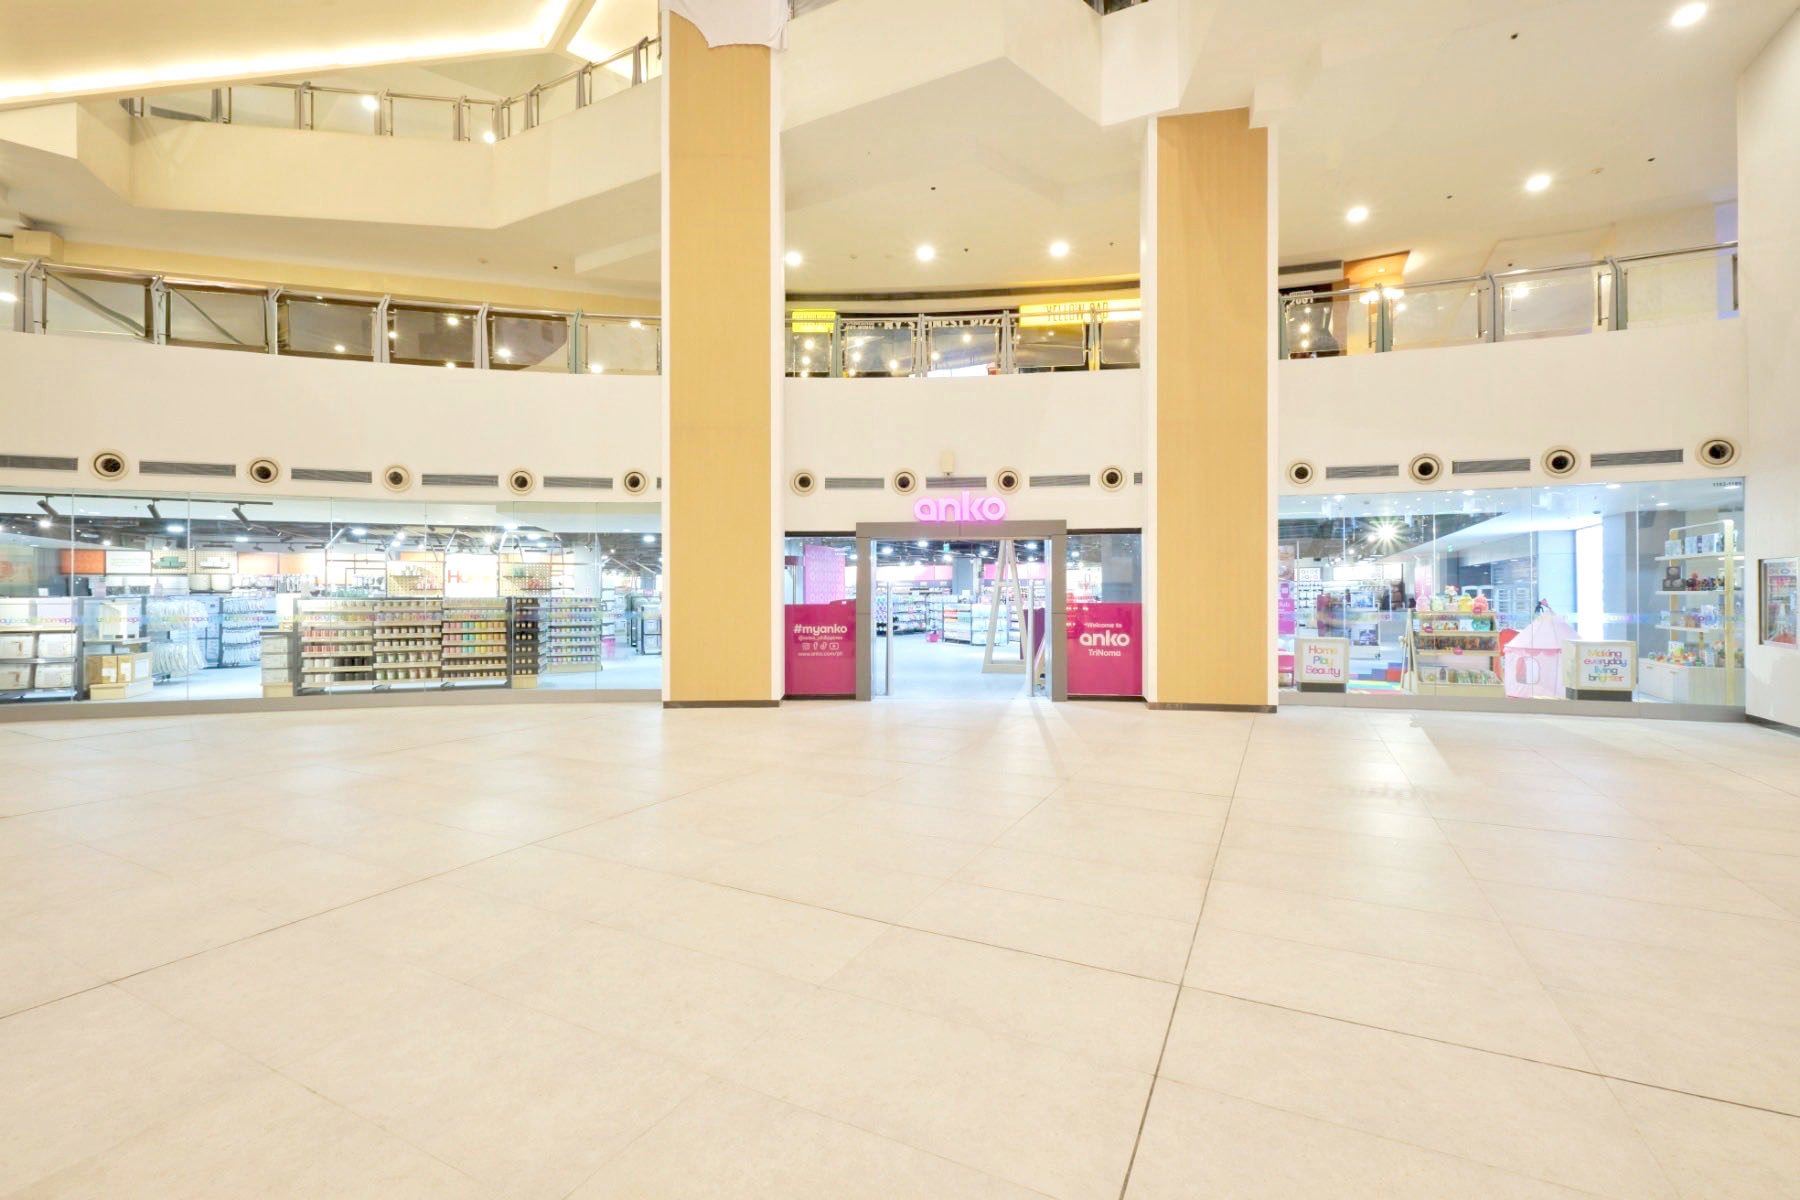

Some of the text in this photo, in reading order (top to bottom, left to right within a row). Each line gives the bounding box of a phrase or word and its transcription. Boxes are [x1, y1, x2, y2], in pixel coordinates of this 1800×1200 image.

[1046, 304, 1085, 321] YELLOW
[914, 490, 1006, 521] anko
[794, 624, 847, 635] #myanko
[1080, 630, 1130, 646] anko
[1308, 645, 1338, 655] Home
[1587, 649, 1623, 659] Making
[1313, 655, 1335, 668] Play
[1583, 658, 1628, 668] everyday
[1305, 665, 1341, 678] Beauty
